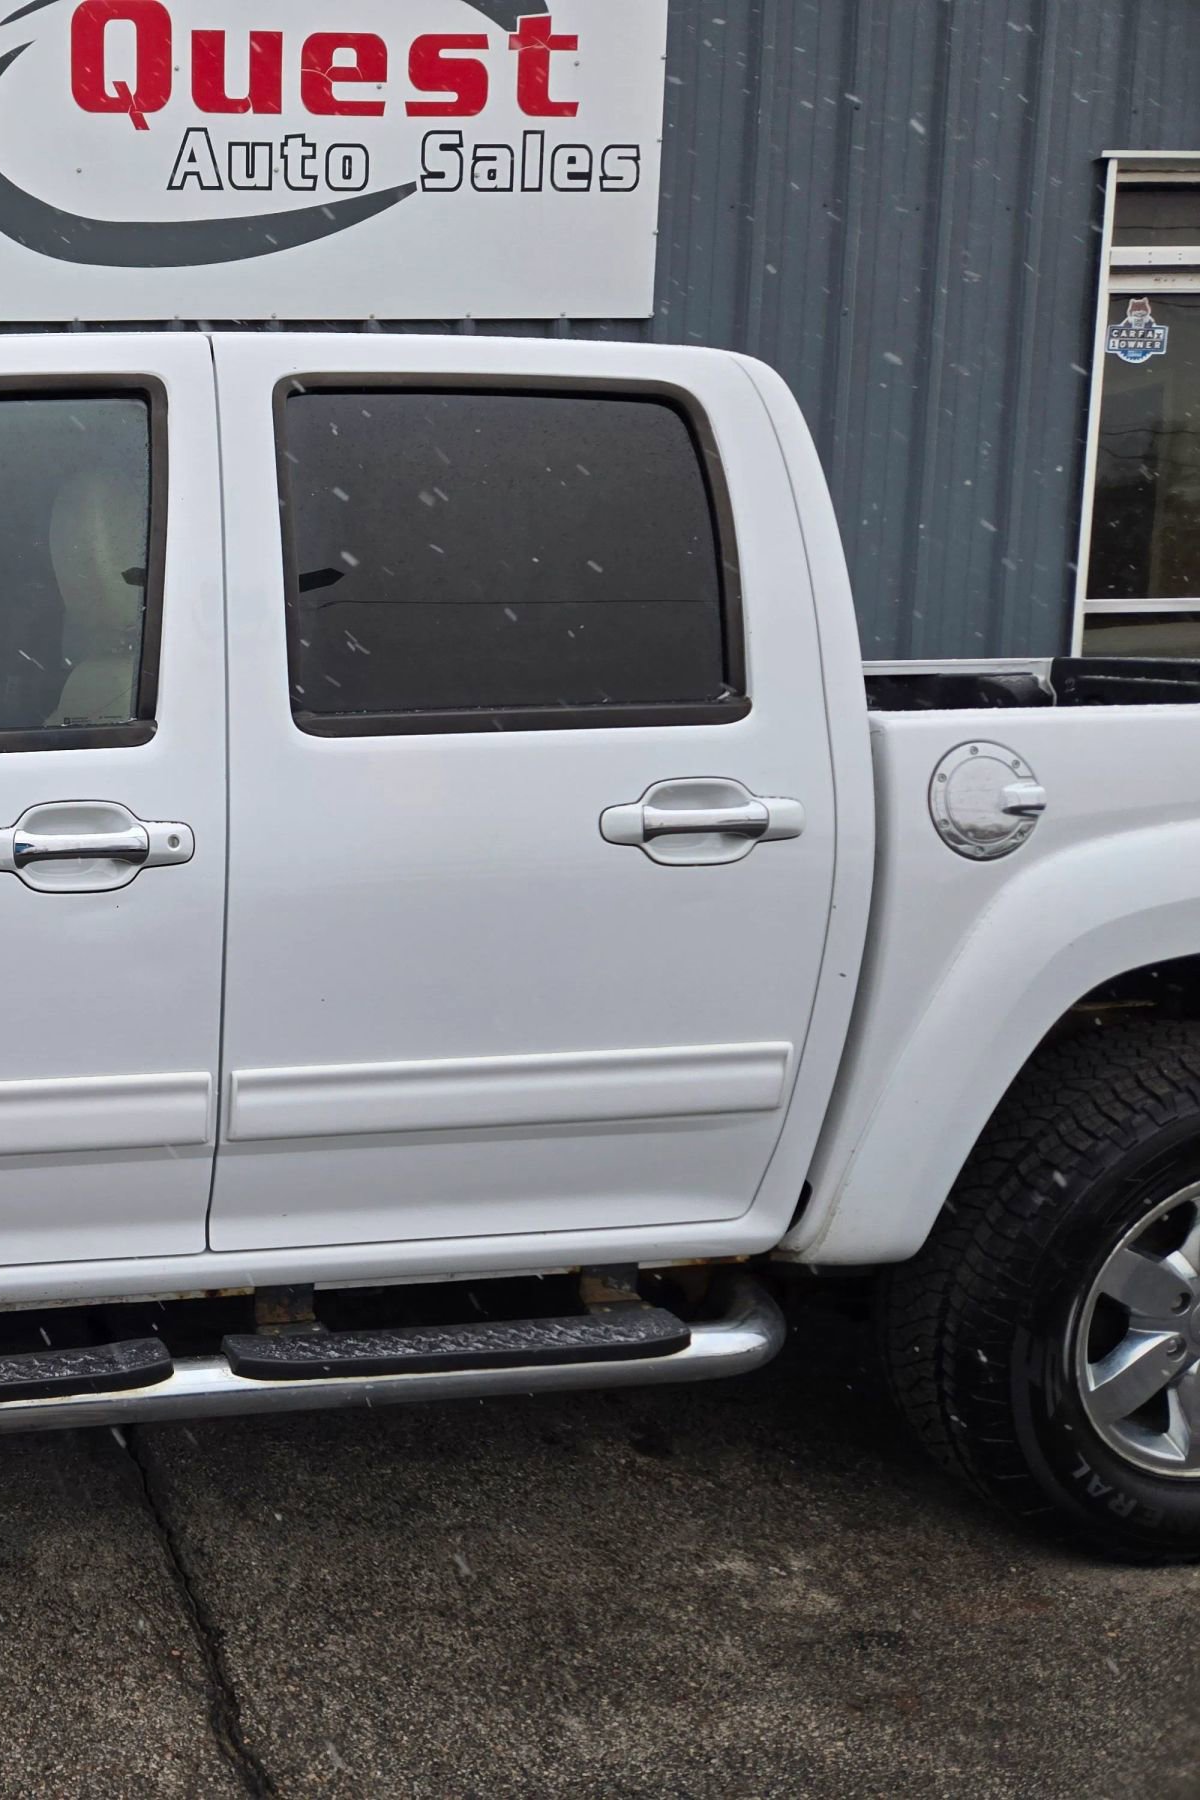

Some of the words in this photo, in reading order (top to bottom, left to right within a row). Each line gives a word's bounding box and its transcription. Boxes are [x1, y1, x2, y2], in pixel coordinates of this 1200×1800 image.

[71, 0, 579, 130] Quest
[166, 127, 369, 191] Auto
[420, 130, 641, 192] Sales
[1120, 340, 1161, 349] OWNER
